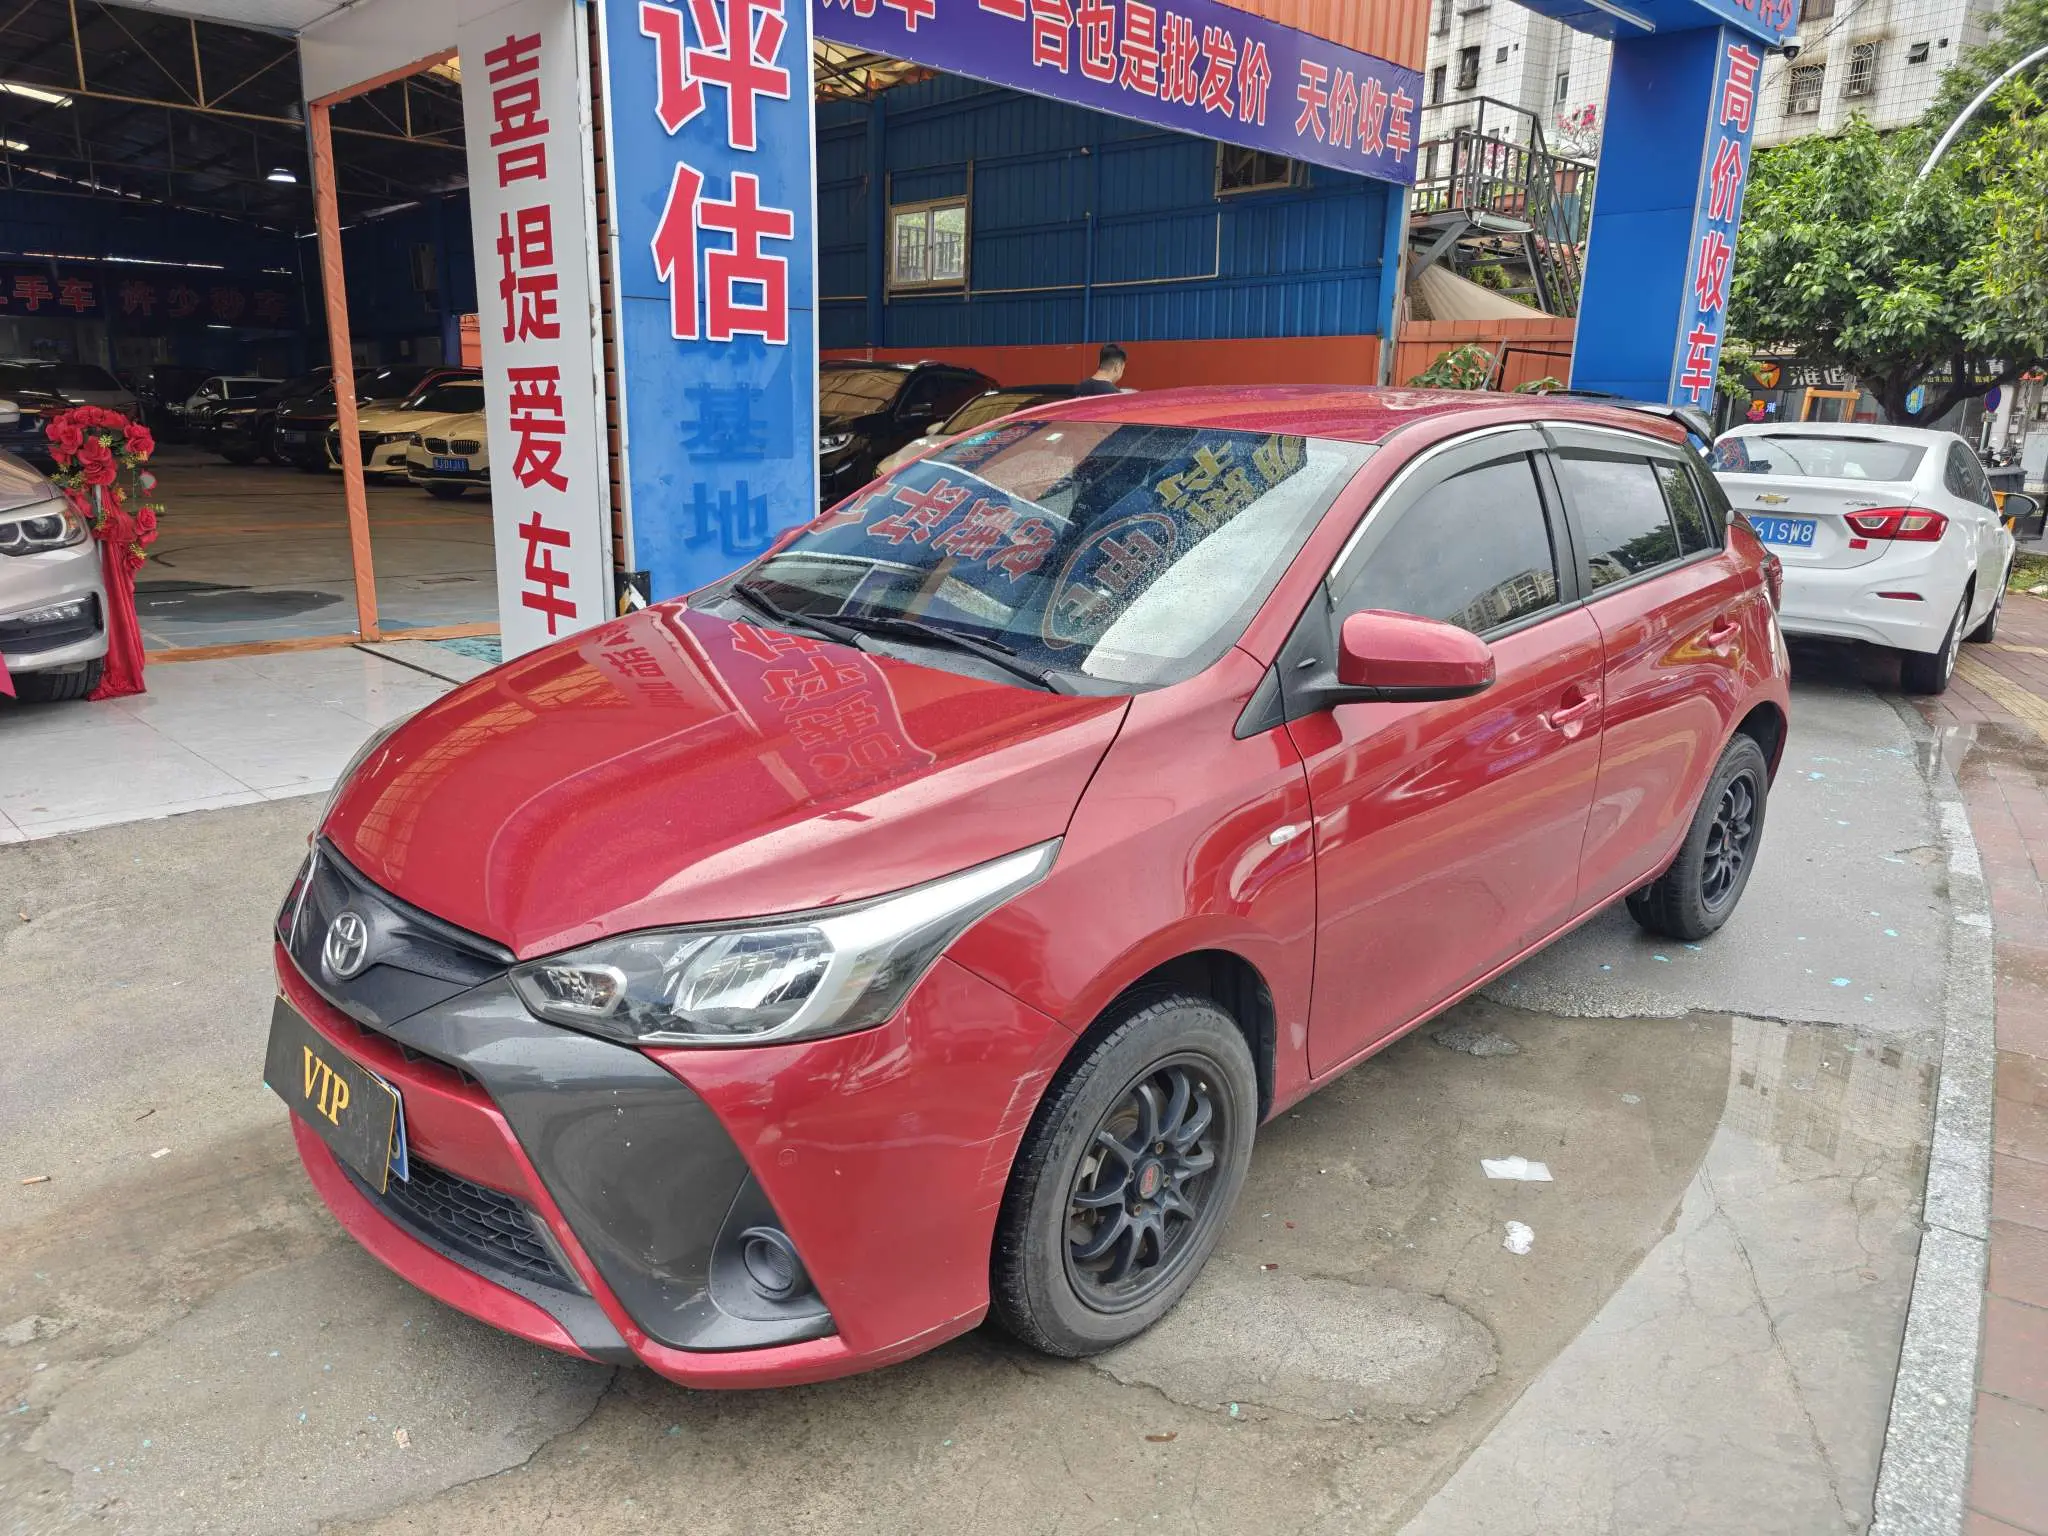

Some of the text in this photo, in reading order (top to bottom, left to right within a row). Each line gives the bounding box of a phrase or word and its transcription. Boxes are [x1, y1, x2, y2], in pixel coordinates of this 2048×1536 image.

[639, 0, 795, 344] 评估
[1296, 59, 1414, 162] 天价收车
[1680, 44, 1759, 402] 高价收车
[484, 33, 577, 636] 喜提爱车
[303, 1045, 350, 1127] VIP
